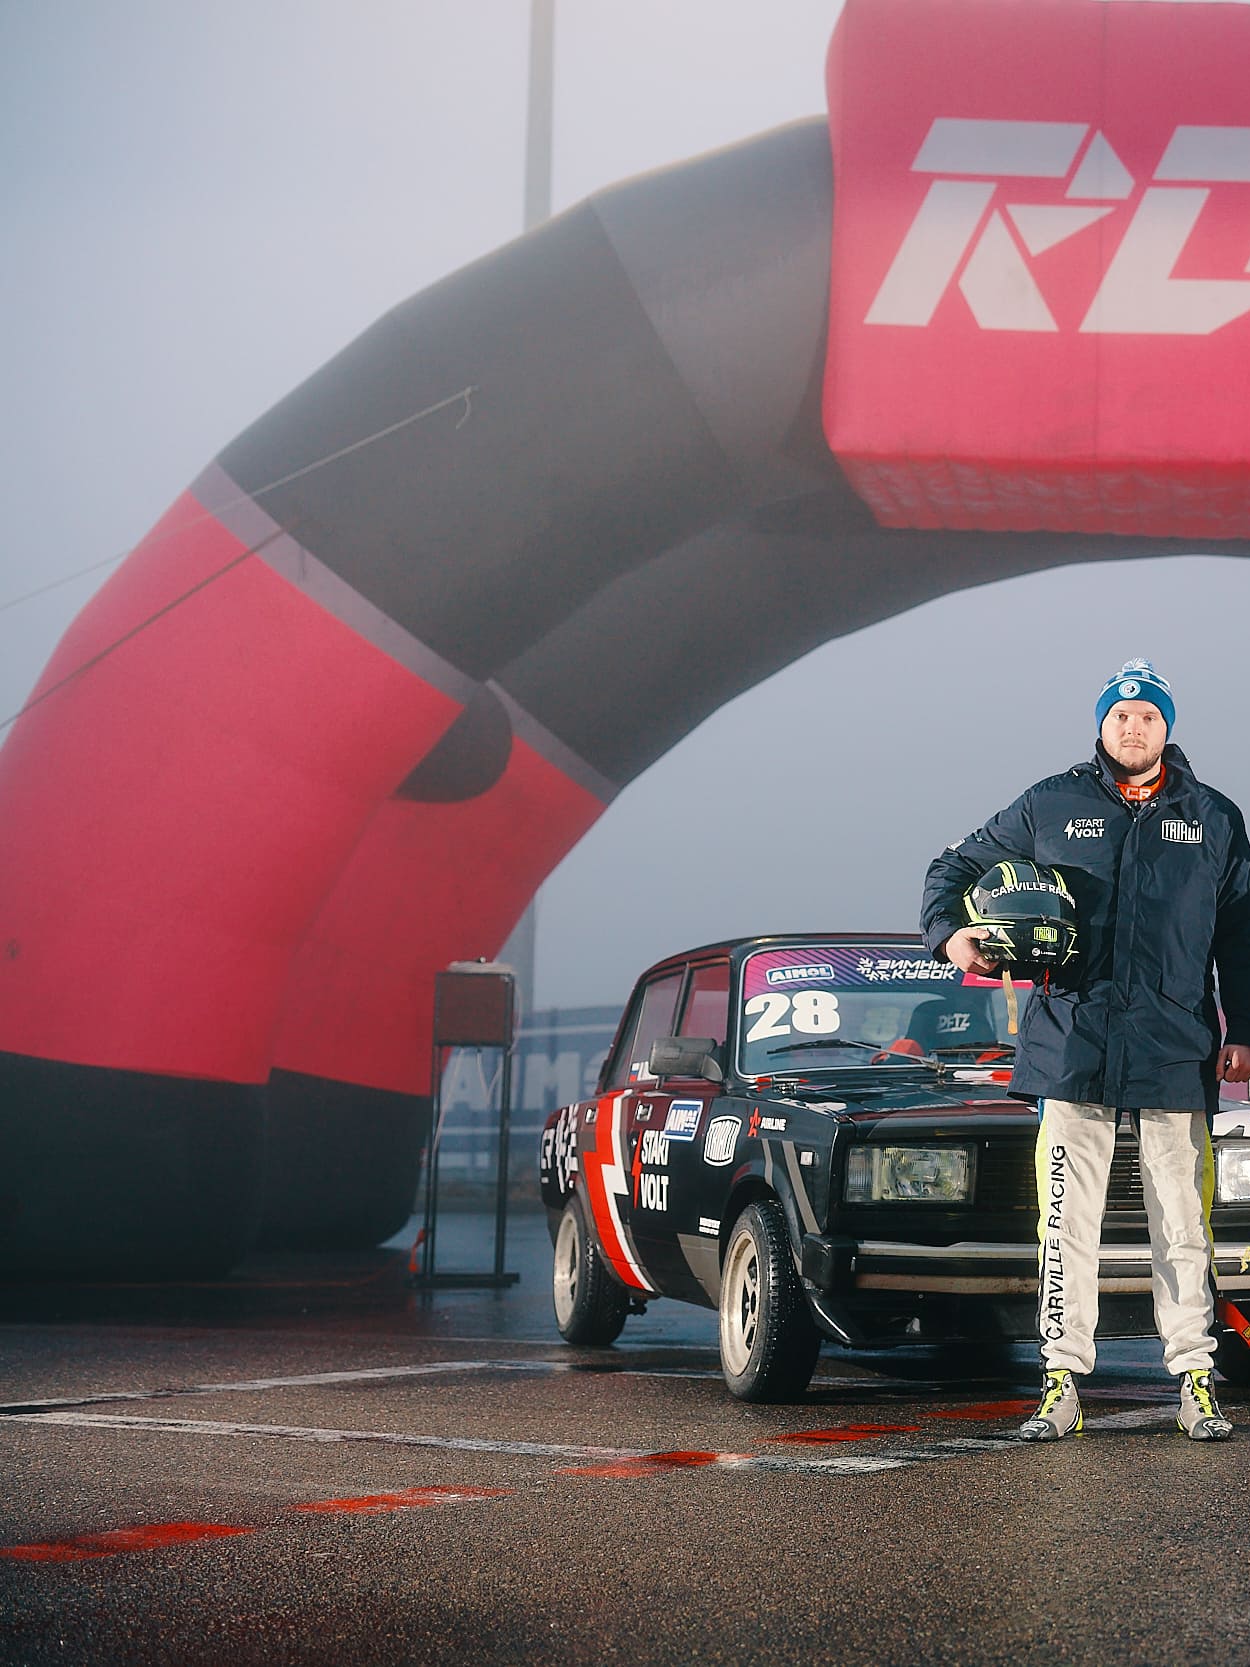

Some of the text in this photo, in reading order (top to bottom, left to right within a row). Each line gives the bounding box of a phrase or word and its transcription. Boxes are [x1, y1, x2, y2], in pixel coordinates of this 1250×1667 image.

[1074, 818, 1105, 828] START
[1074, 828, 1105, 838] VOLT
[991, 882, 1046, 898] CARVILLE
[770, 966, 831, 983] AIMOL
[891, 969, 957, 980] КУБОК
[745, 991, 841, 1043] 28
[760, 1117, 787, 1131] AIRLINE
[641, 1130, 669, 1165] START
[640, 1173, 669, 1211] VOLT
[1046, 1145, 1065, 1341] CARVILLE RACING
